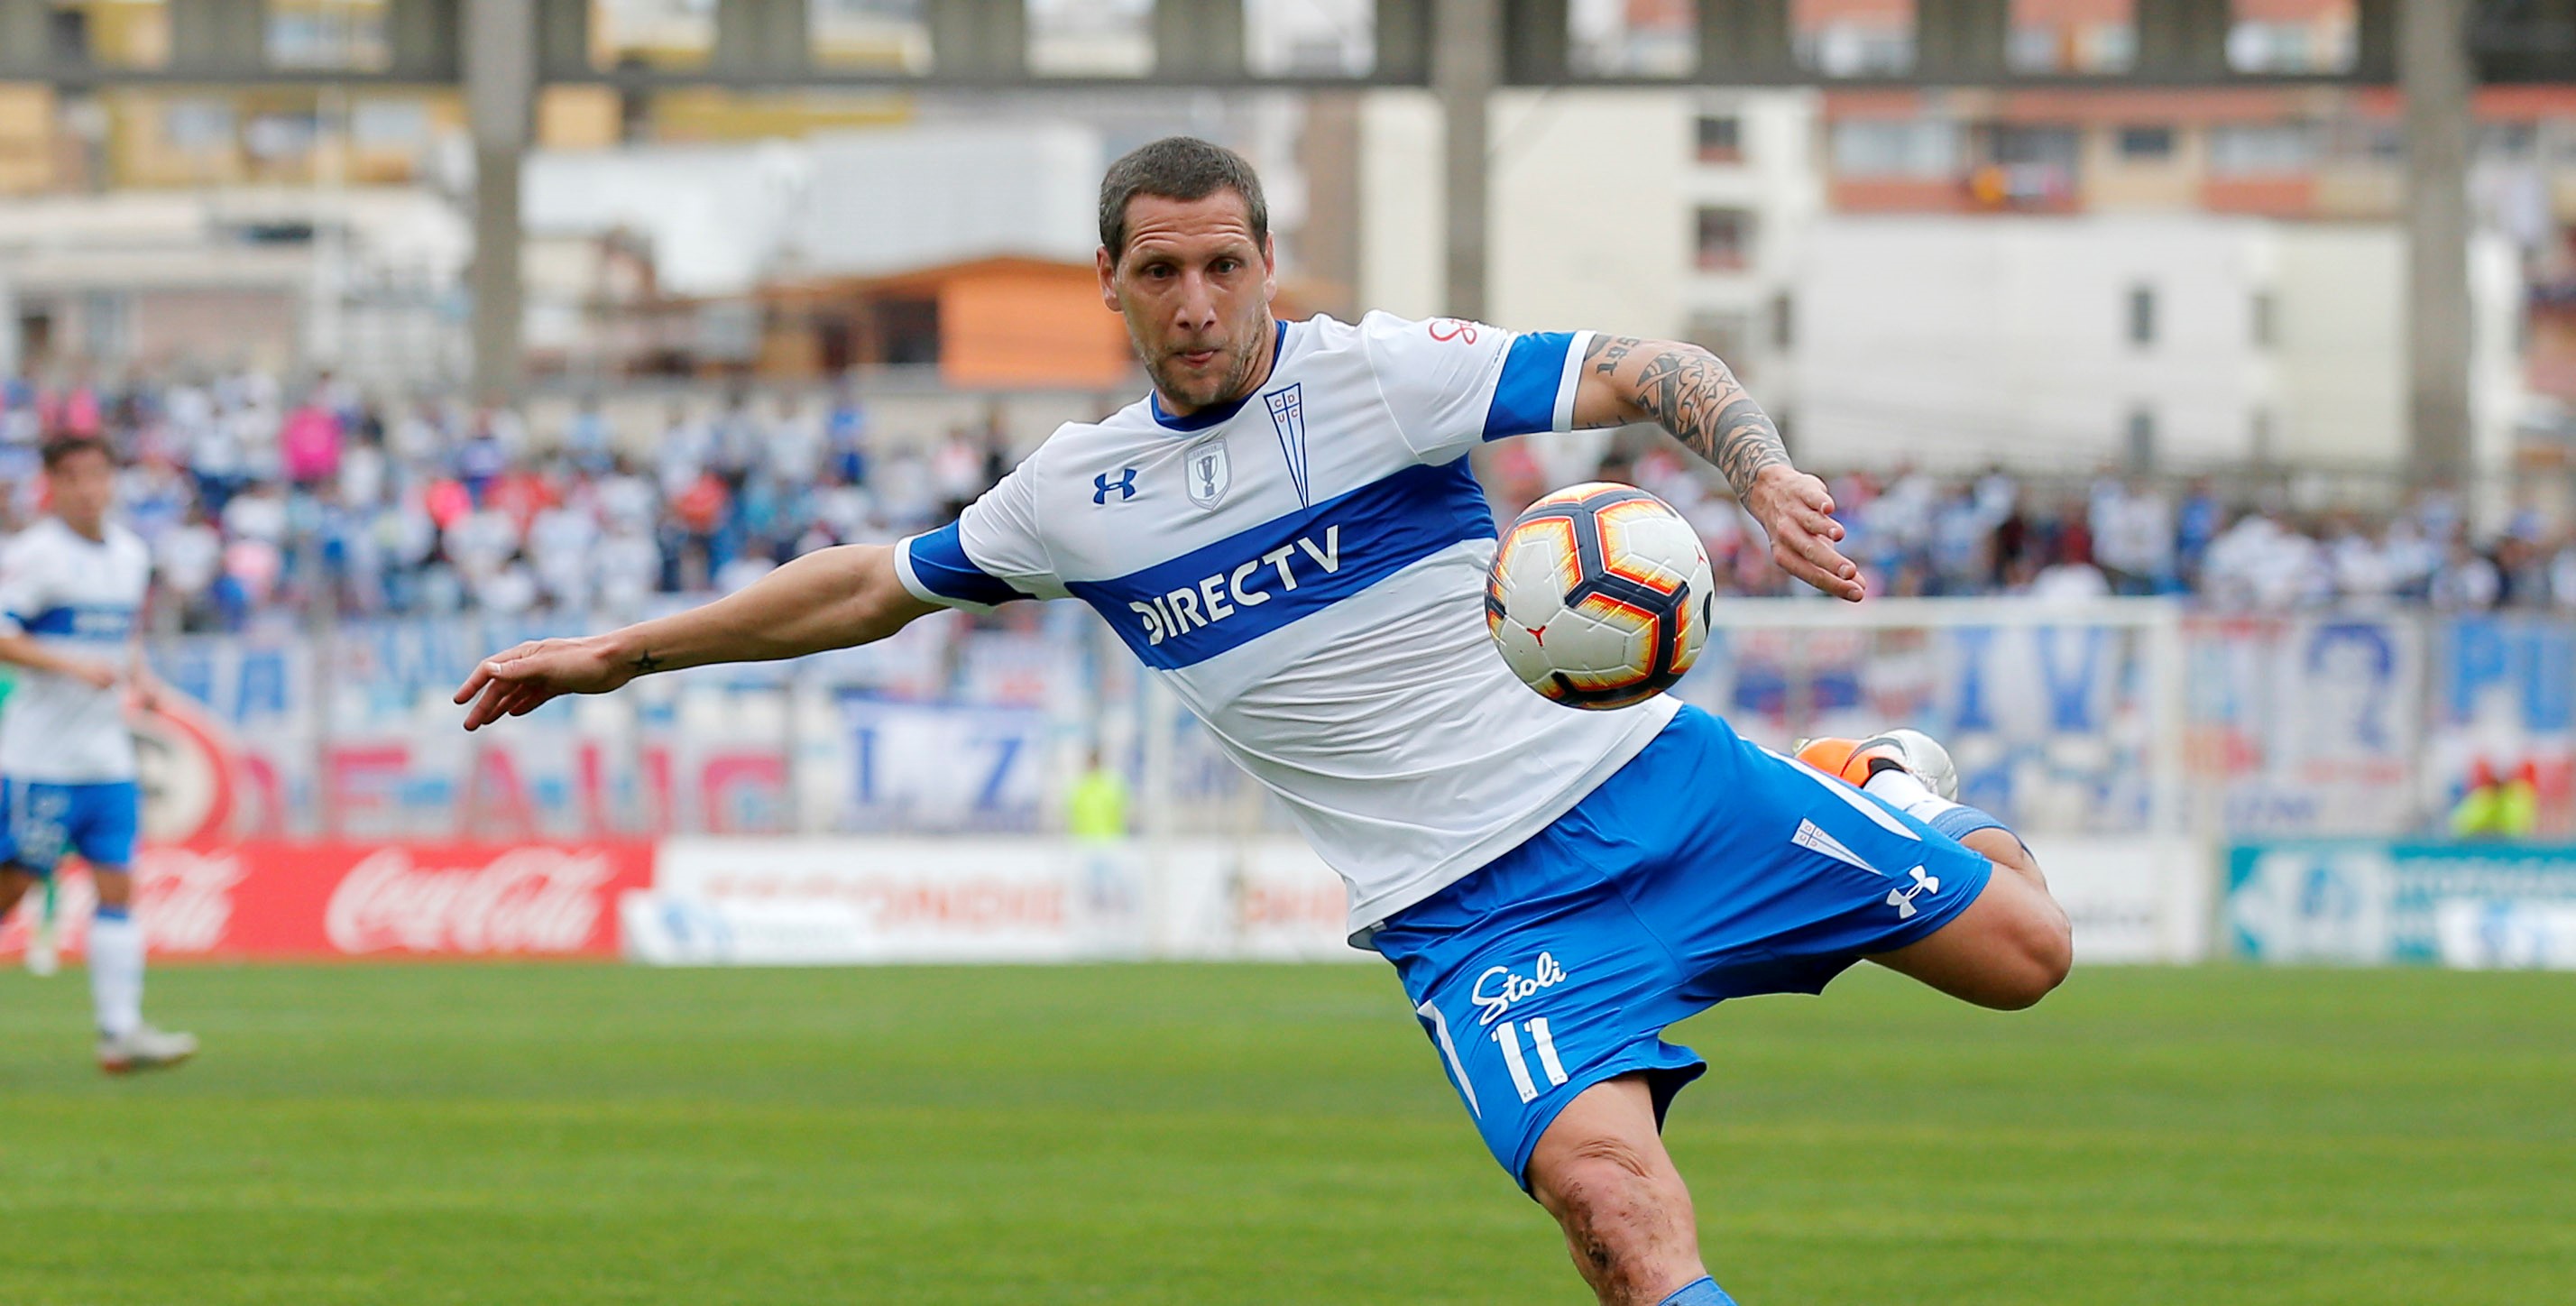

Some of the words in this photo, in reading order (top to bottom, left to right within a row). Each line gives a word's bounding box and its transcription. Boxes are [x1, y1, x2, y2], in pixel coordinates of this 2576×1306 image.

[1128, 524, 1339, 646] DIRECTV
[1471, 951, 1567, 1026] Stoli
[1490, 1016, 1569, 1105] 11
